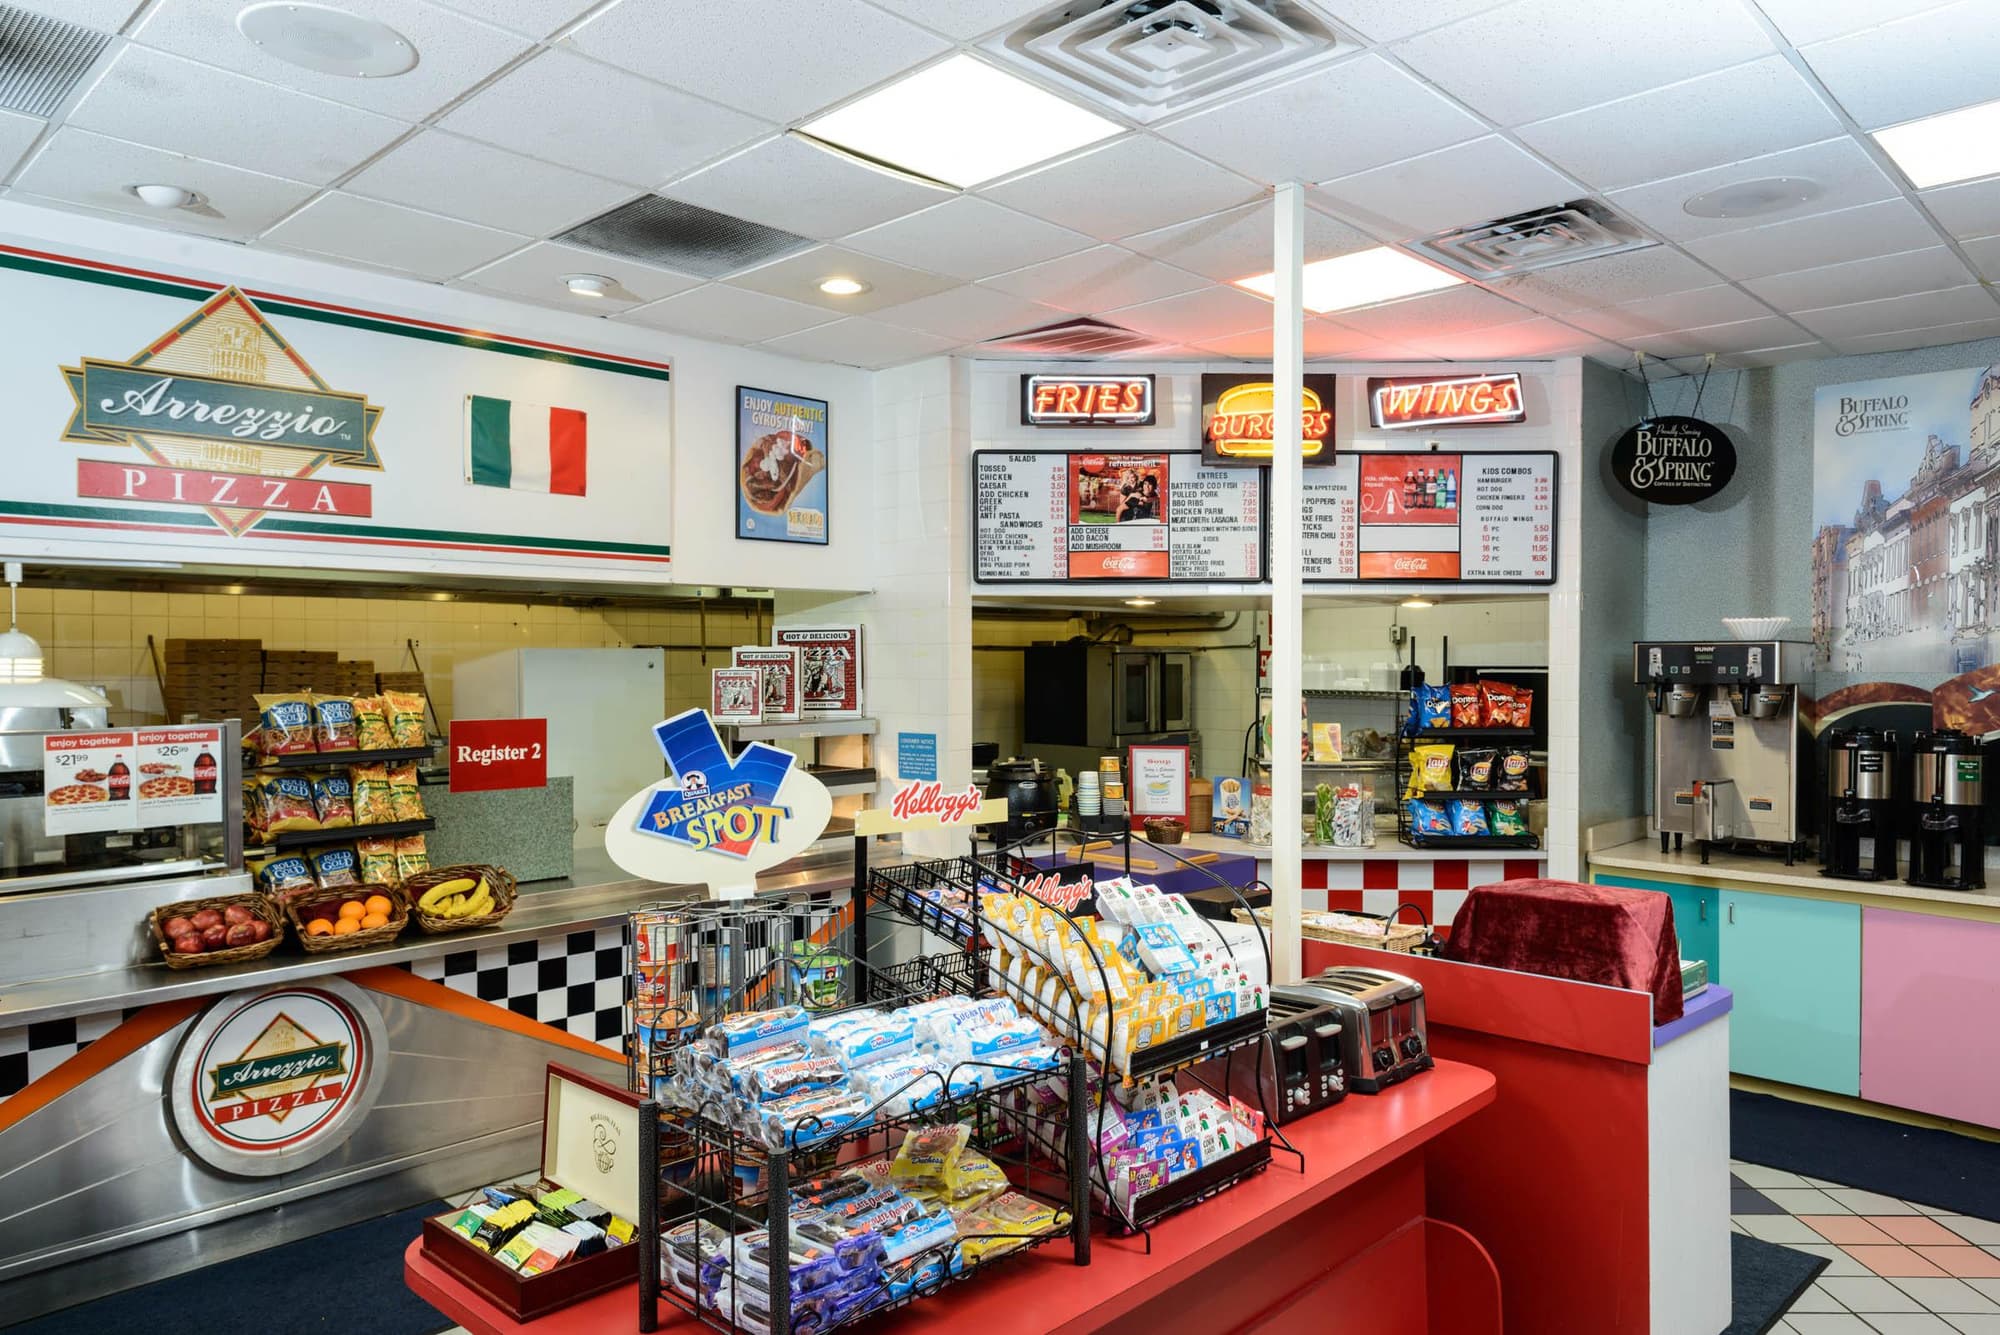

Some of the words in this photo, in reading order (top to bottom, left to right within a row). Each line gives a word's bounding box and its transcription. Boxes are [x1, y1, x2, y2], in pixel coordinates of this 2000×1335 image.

[100, 378, 347, 440] Arrezzio
[744, 396, 772, 412] ENJOY
[774, 402, 824, 422] AUTHENTIC
[1036, 382, 1144, 414] FRIES
[1384, 382, 1518, 416] WINGS
[1840, 395, 1908, 415] BUFFALO
[752, 412, 782, 428] GYROS
[1211, 412, 1332, 438] BURRS
[1656, 424, 1678, 437] Proudly
[1679, 424, 1701, 438] Serving
[1835, 415, 1858, 437] &
[1636, 430, 1712, 457] BUFFALO
[1630, 456, 1658, 488] &
[1656, 456, 1712, 482] SPRING
[121, 468, 338, 513] PIZZA
[1483, 524, 1488, 532] 6
[1482, 554, 1489, 562] 22
[809, 632, 848, 640] DELICIOUS
[50, 738, 77, 748] enjoy
[80, 736, 122, 747] together
[140, 733, 166, 743] enjoy
[168, 732, 208, 742] together
[456, 744, 528, 766] Register
[532, 742, 541, 759] 2
[654, 783, 753, 830] BREAKFAST
[892, 782, 981, 823] Kellogg's
[686, 804, 790, 852] SPOT
[322, 858, 354, 870] GOLD
[324, 851, 351, 862] ROLD
[1020, 872, 1093, 912] Kellogg's
[952, 1010, 978, 1026] SUGAR
[977, 1000, 1006, 1019] DONUTS
[223, 1053, 331, 1086] Arrezzio
[232, 1088, 326, 1120] PIZZA
